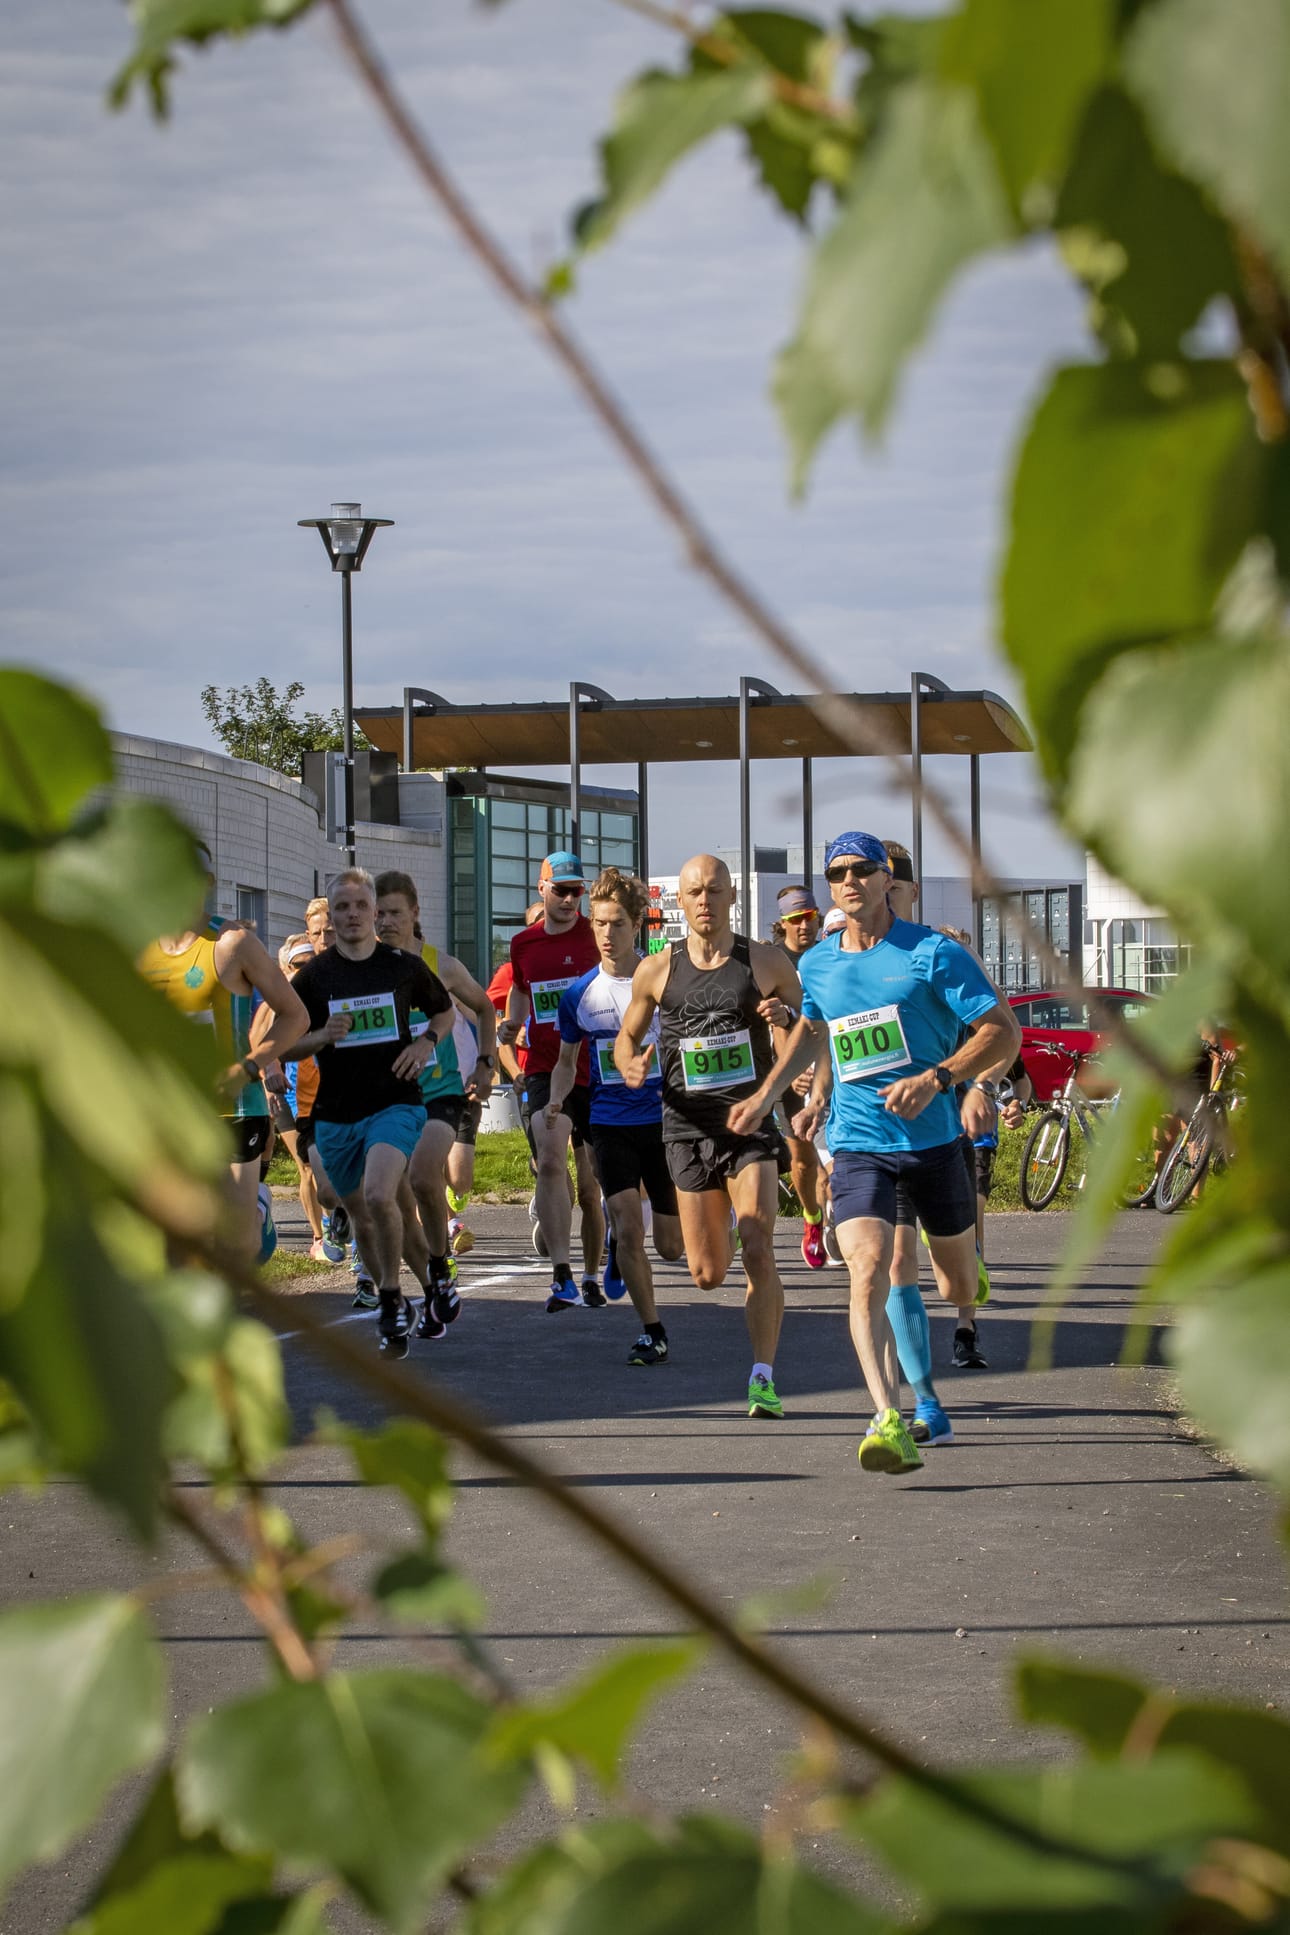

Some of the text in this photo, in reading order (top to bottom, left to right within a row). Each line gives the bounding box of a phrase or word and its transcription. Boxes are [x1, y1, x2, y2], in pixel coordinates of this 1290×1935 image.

[540, 991, 560, 1011] 90
[840, 1026, 889, 1060] 910
[694, 1047, 742, 1074] 915
